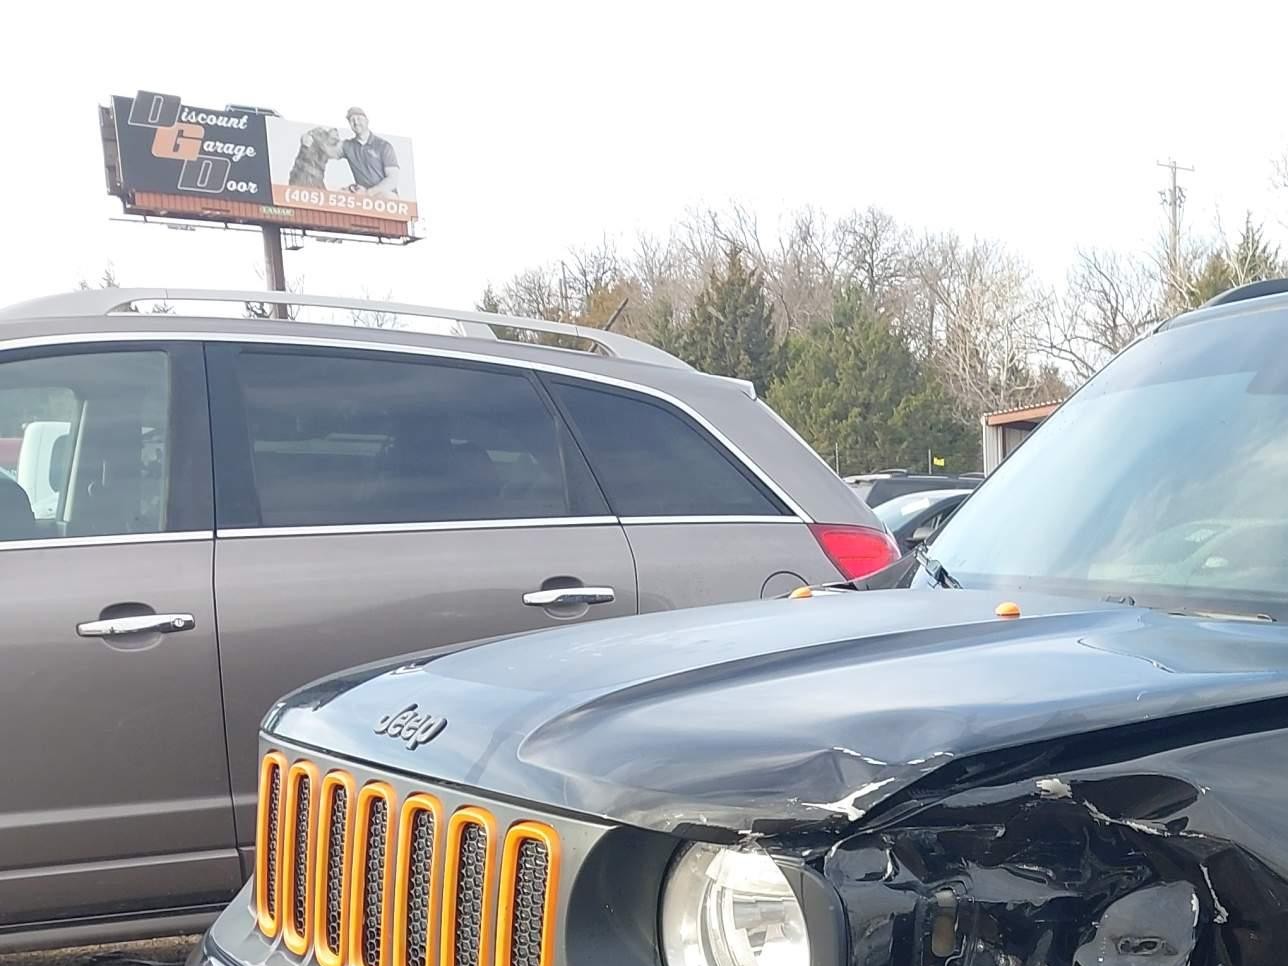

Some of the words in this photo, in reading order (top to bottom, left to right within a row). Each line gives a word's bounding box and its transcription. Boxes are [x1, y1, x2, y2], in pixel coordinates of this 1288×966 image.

[285, 187, 325, 206] (405)
[328, 193, 409, 216] 525-DOOR
[373, 703, 448, 752] Jeep
